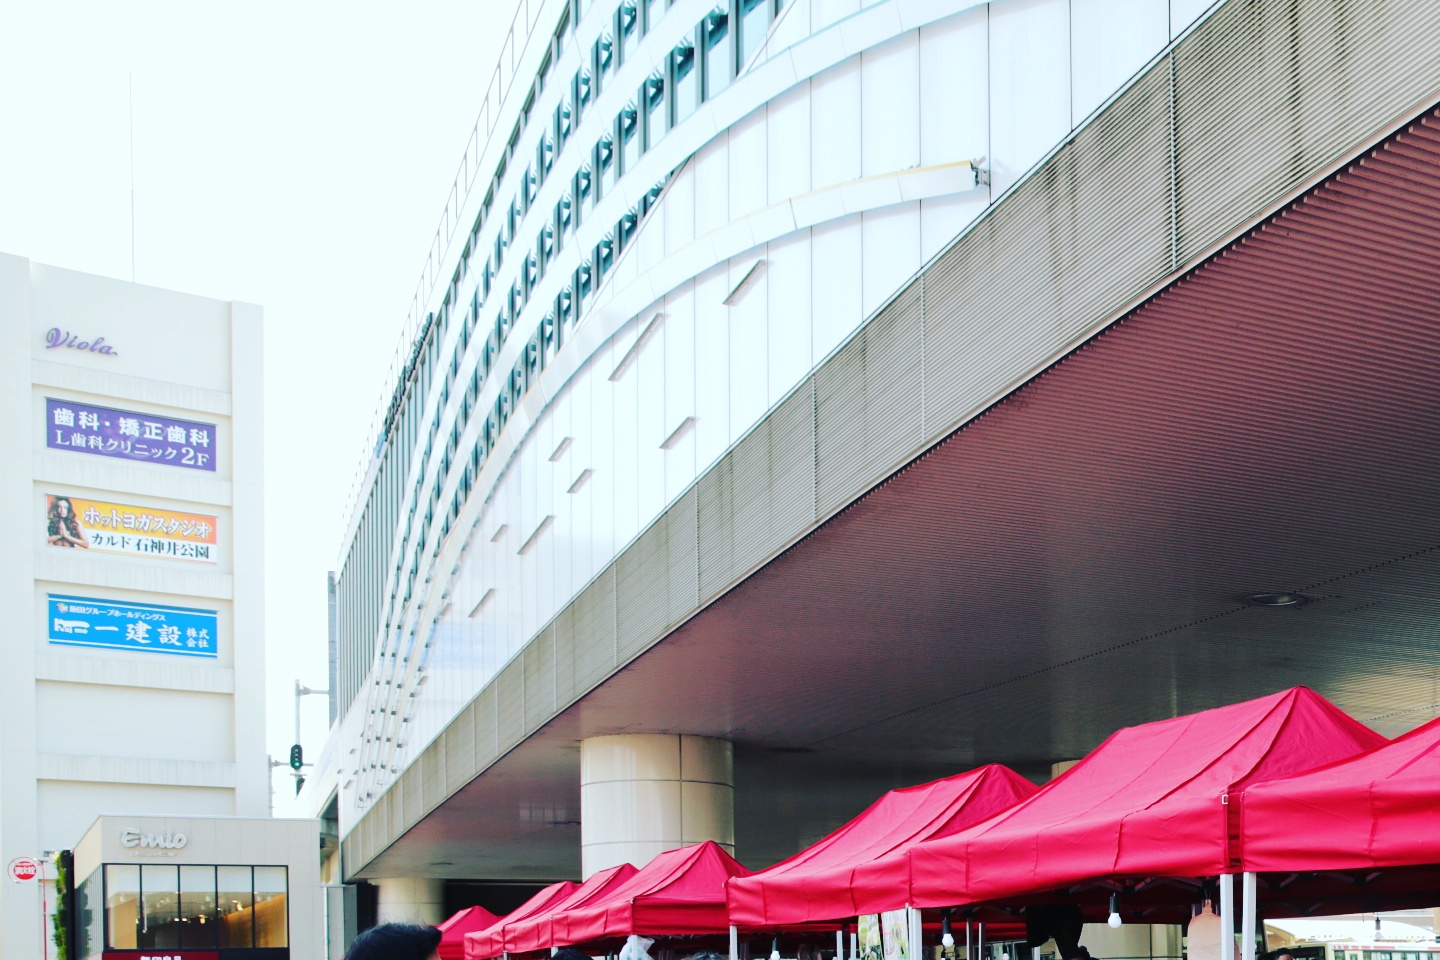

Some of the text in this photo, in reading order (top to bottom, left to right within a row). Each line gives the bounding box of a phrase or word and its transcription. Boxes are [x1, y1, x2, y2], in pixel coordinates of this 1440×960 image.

[46, 327, 118, 356] Viola
[53, 407, 210, 448] 歯科・矯正歯科
[181, 446, 210, 466] 2F
[84, 506, 211, 539] ホットヨガスタジオ
[91, 532, 210, 559] カルド 石神井公園
[120, 827, 188, 849] Emio
